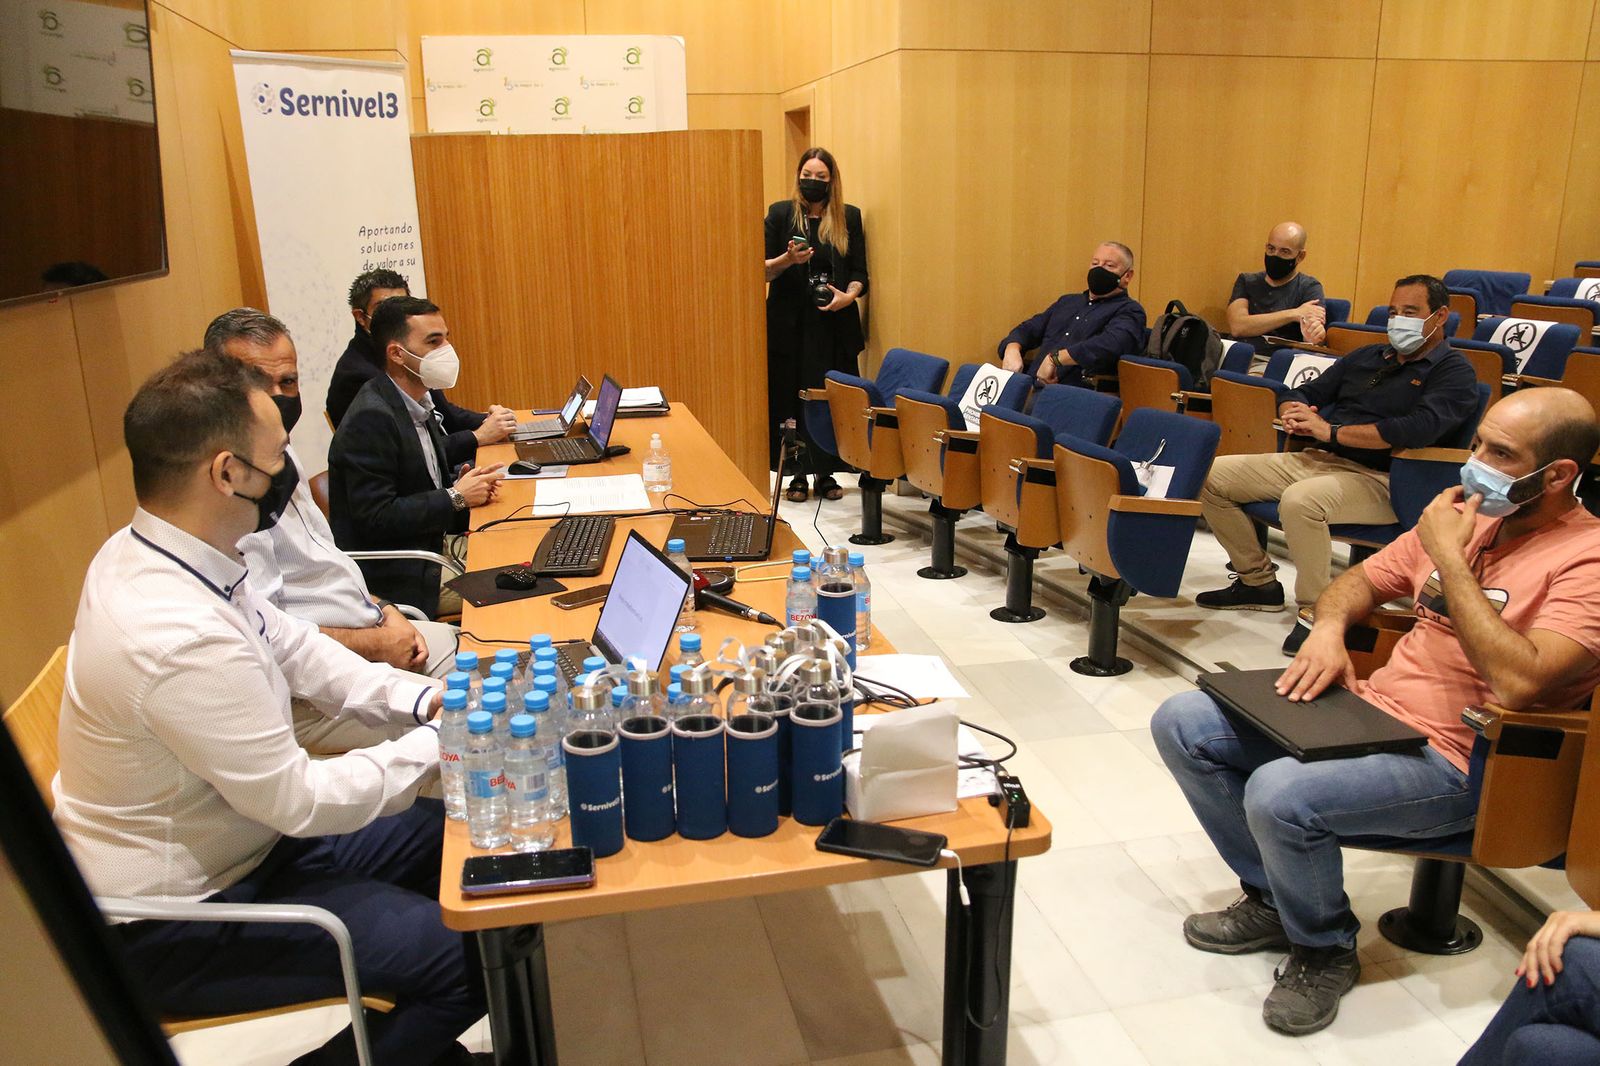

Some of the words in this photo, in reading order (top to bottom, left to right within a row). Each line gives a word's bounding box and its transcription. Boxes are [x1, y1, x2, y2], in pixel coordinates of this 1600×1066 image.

[279, 87, 399, 119] Sernivel3
[358, 221, 413, 240] Aportando
[360, 241, 414, 254] soluciones
[362, 259, 374, 271] de
[377, 257, 397, 269] valor
[399, 259, 404, 267] a
[406, 257, 416, 266] su
